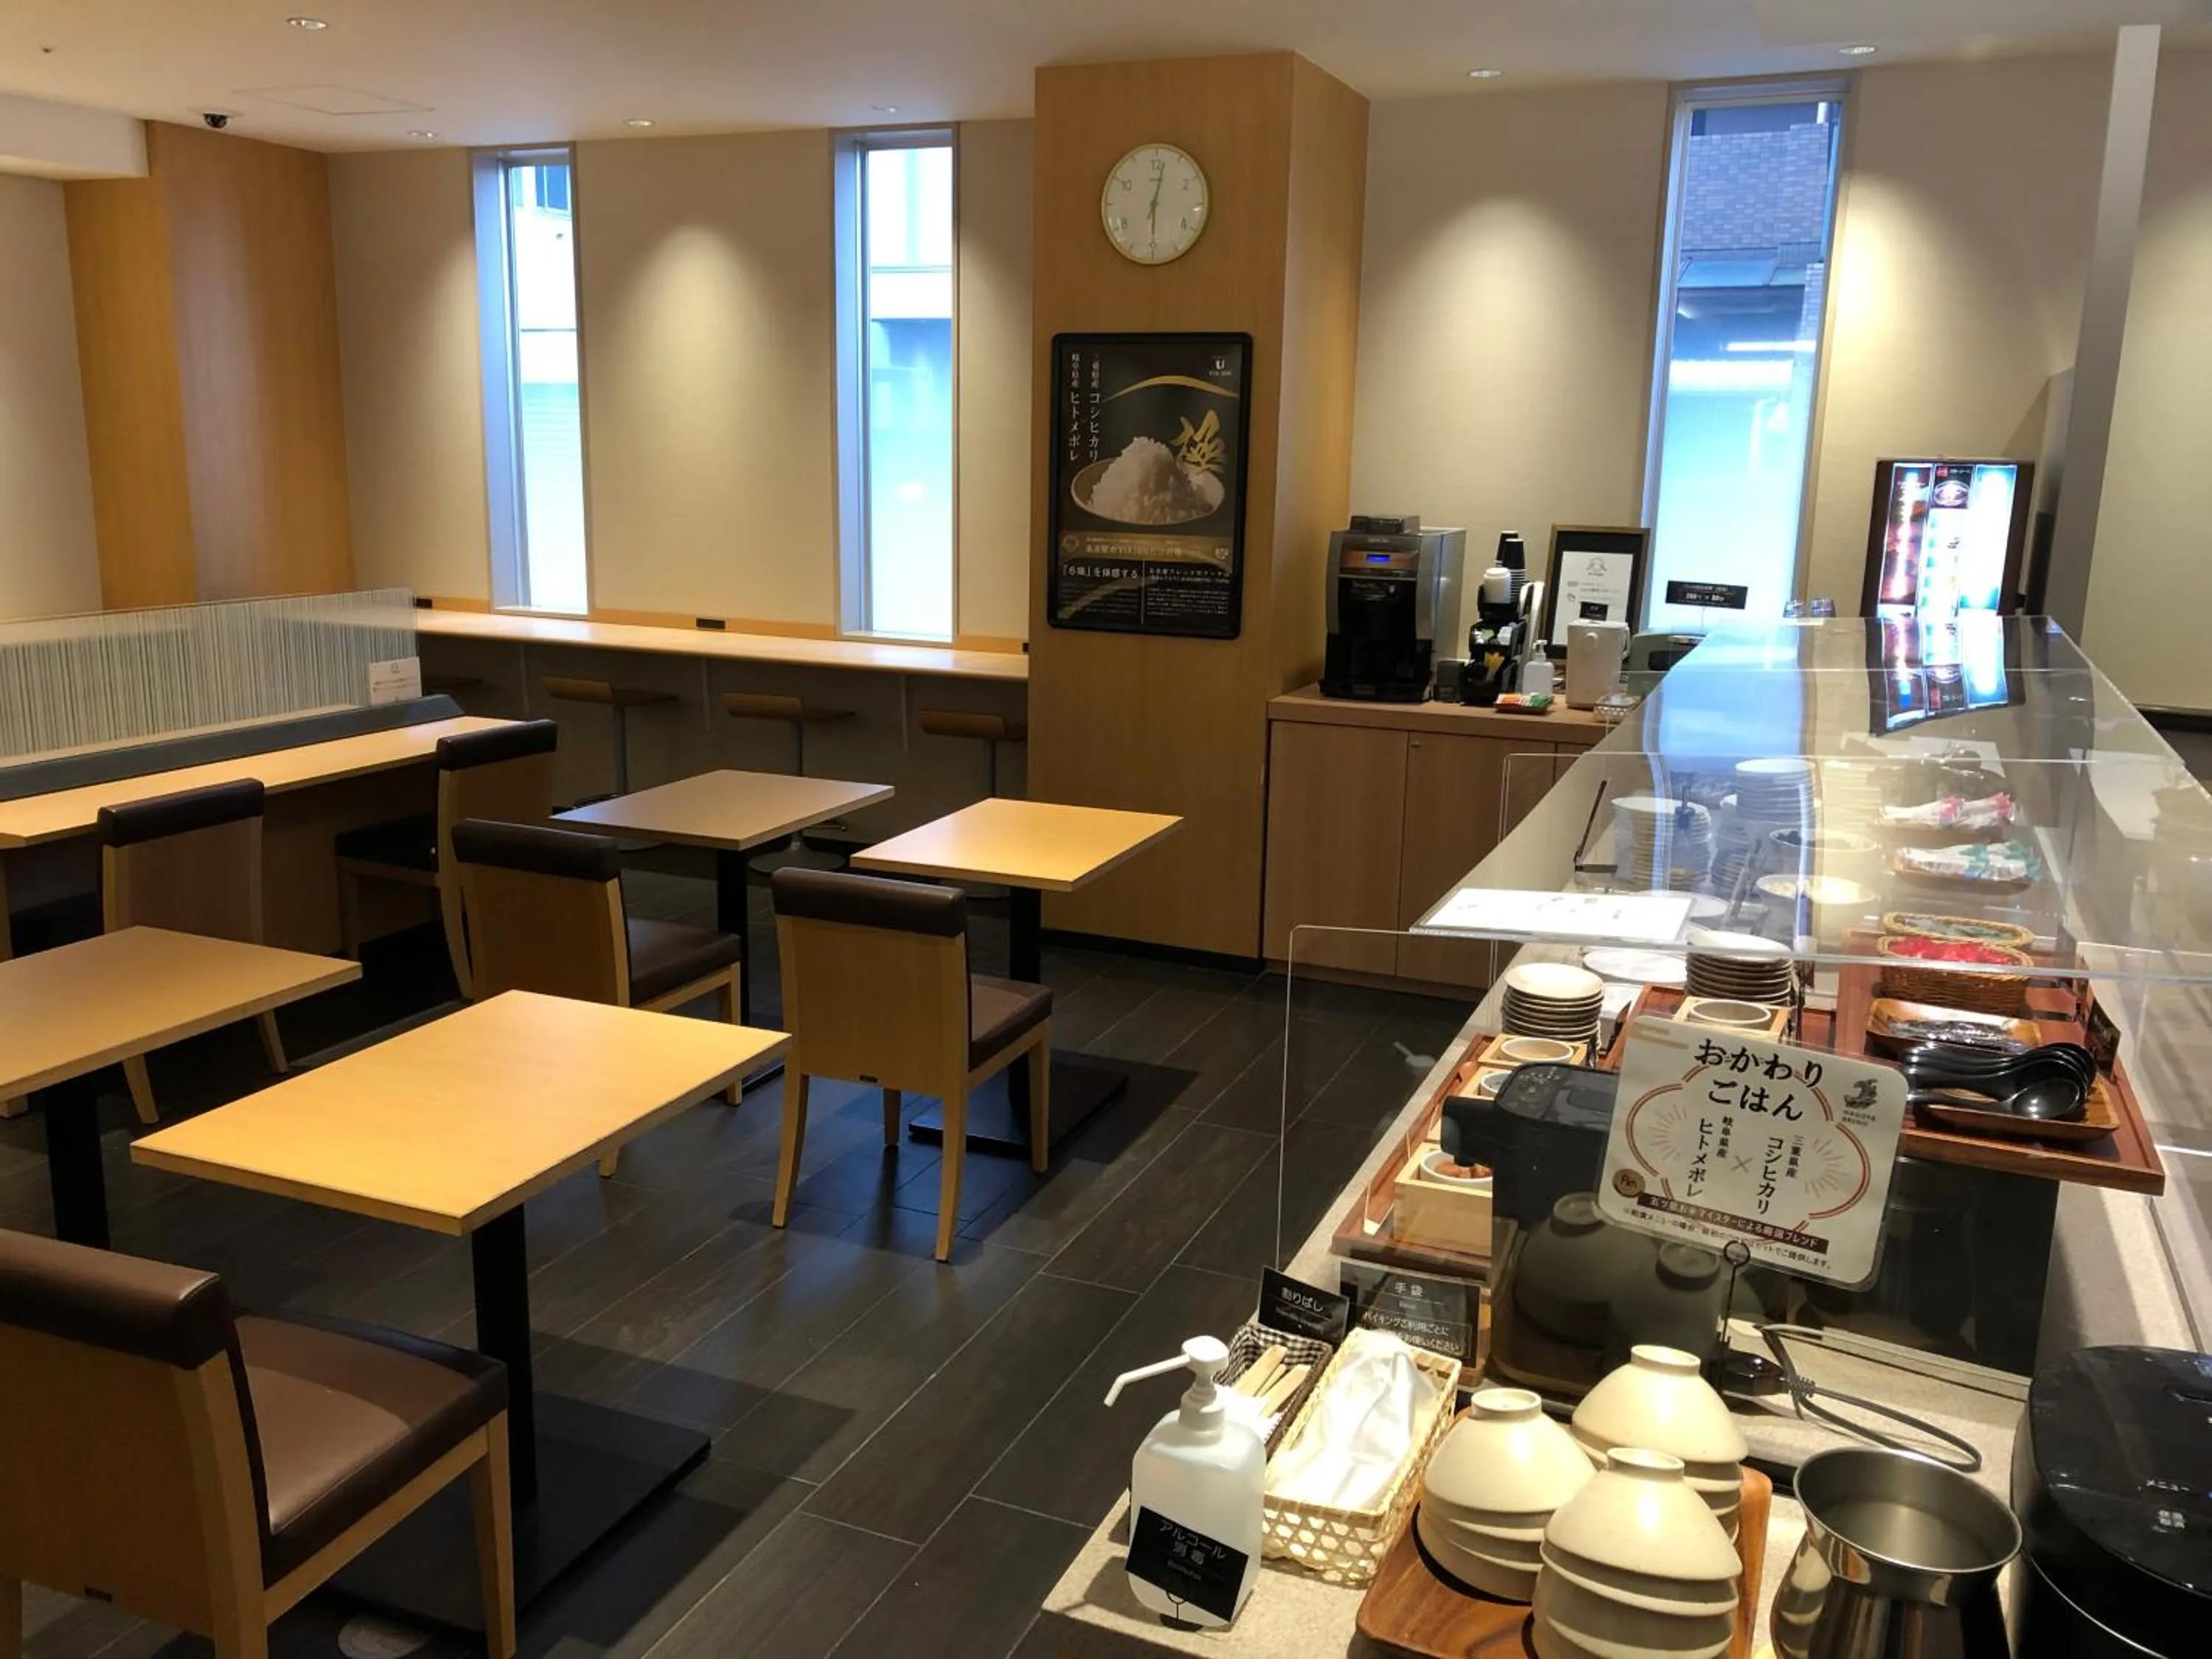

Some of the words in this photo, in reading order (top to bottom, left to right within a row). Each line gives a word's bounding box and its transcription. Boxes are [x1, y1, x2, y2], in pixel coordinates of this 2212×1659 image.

[1694, 1038, 1823, 1088] おかわり
[1708, 1079, 1803, 1121] ごはん
[1686, 1118, 1714, 1198] ヒトメボレ
[1716, 1116, 1734, 1158] 岐阜県産
[1785, 1135, 1806, 1179] 三重県産
[1756, 1136, 1784, 1215] コシヒカリ
[1394, 1281, 1423, 1298] 手袋
[1158, 1519, 1227, 1559] アルコール
